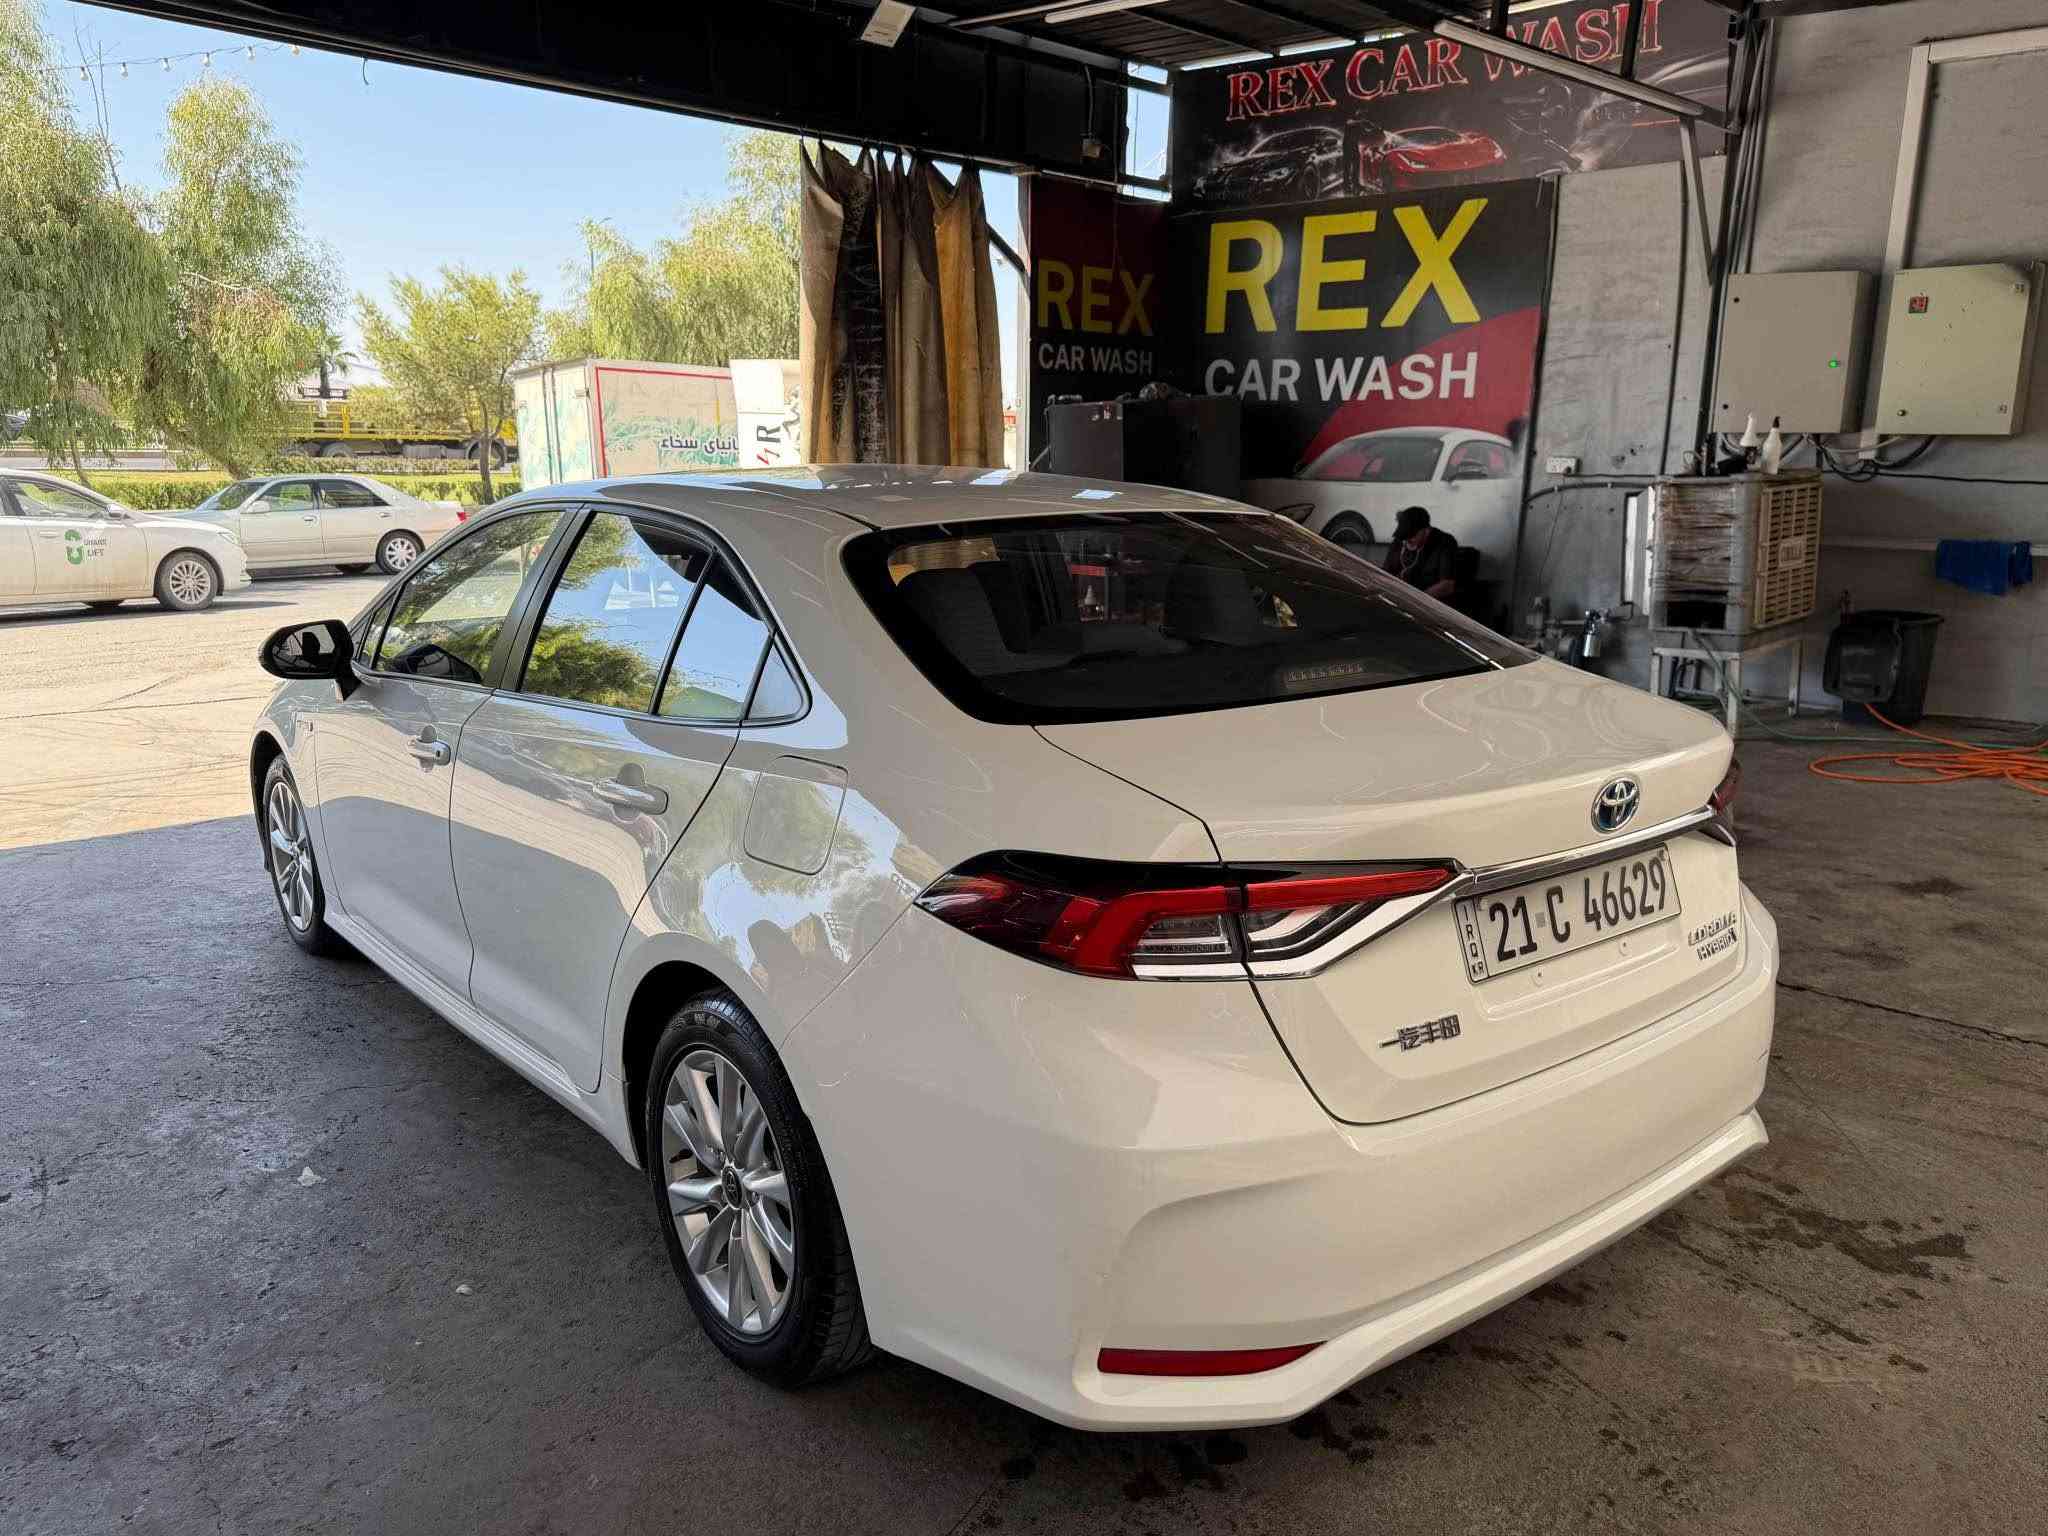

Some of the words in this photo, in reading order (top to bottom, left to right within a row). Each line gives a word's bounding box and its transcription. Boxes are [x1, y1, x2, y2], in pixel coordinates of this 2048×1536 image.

[1226, 58, 1336, 121] REX
[1345, 38, 1468, 101] CAR
[1037, 258, 1154, 336] REX
[1205, 198, 1489, 334] REX
[1038, 343, 1085, 371] CAR
[1090, 347, 1153, 376] WASH
[1204, 358, 1301, 401] CAR
[1314, 352, 1478, 402] WASH
[1489, 895, 1538, 962] 21
[1546, 885, 1571, 944] C
[1584, 855, 1667, 932] 46629
